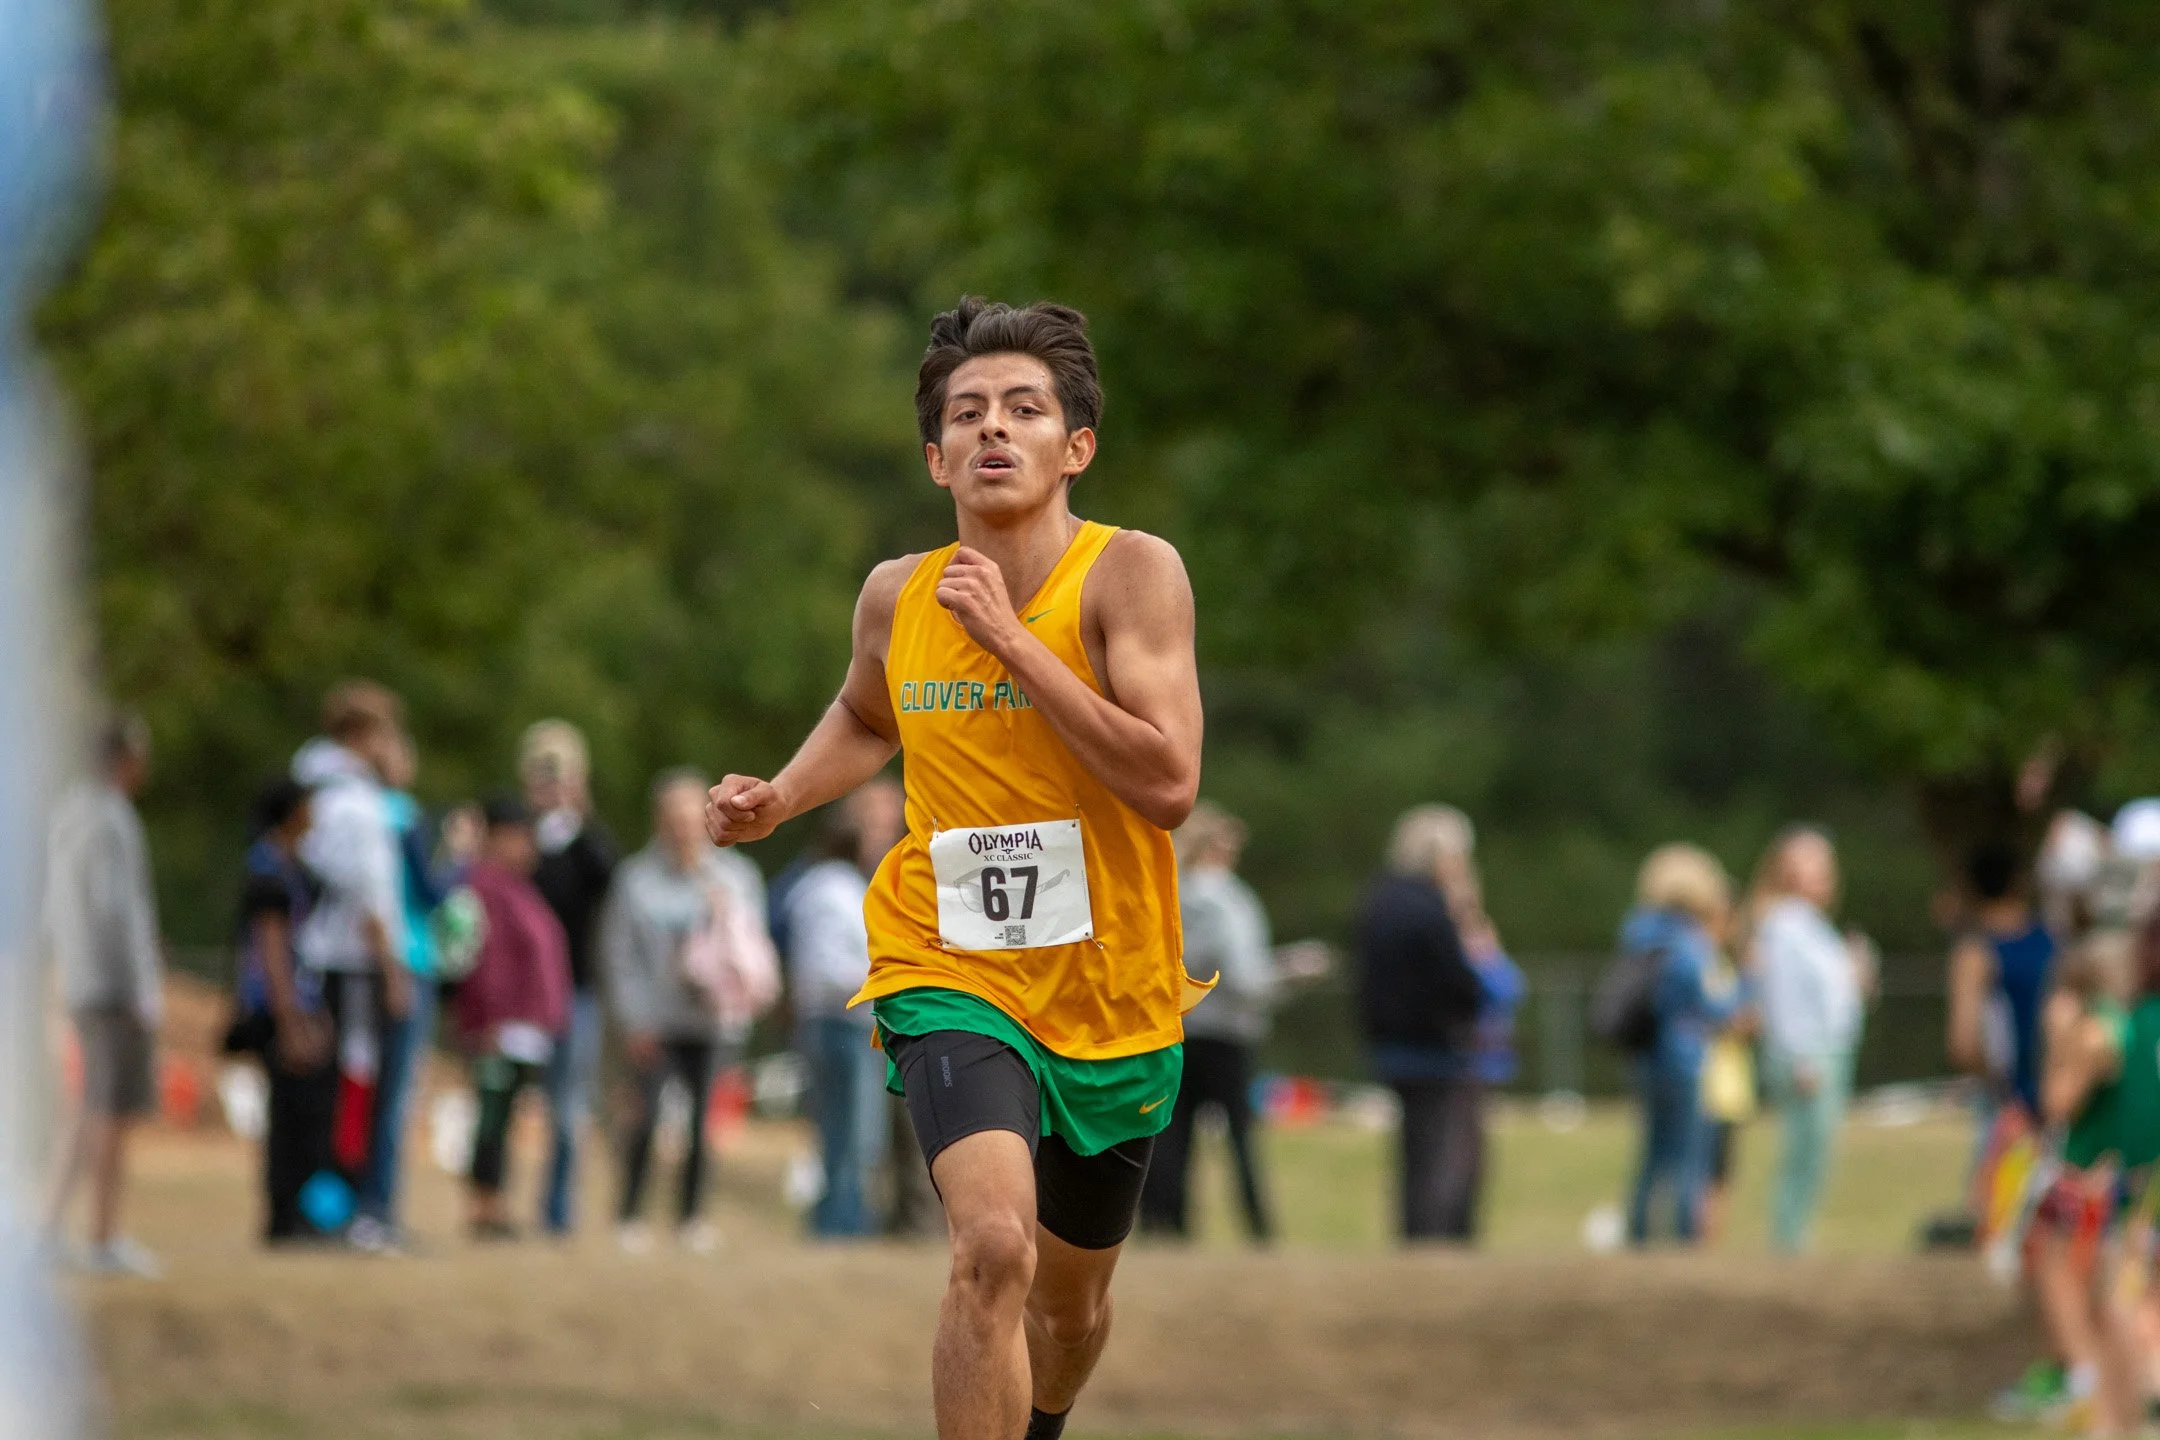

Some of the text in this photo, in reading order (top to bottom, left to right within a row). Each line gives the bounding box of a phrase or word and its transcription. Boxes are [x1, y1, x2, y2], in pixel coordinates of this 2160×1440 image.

[901, 679, 1032, 712] CLOVER PAR
[968, 828, 1043, 855] OLYMPIA
[997, 853, 1034, 861] CLASSIC
[981, 865, 1039, 922] 67
